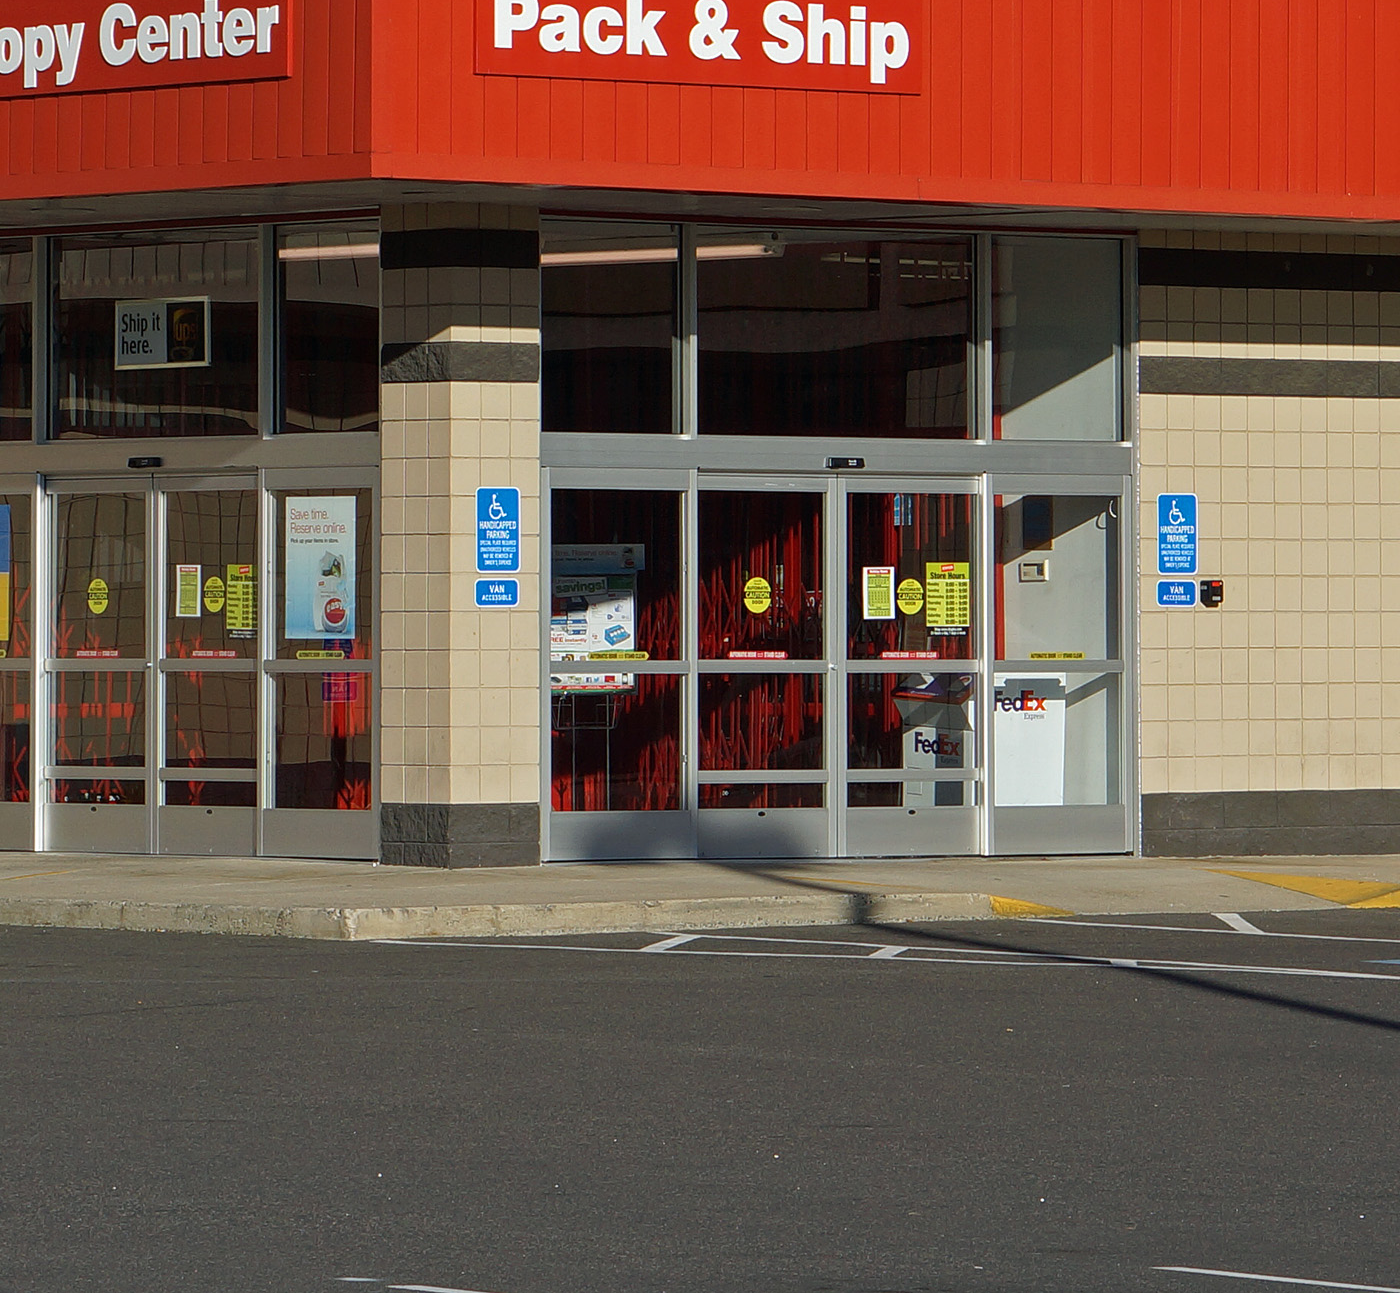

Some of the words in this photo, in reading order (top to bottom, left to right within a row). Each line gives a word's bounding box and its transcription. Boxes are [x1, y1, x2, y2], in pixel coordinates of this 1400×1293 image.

[762, 0, 910, 84] Ship
[121, 312, 148, 337] Ship
[152, 312, 161, 332] it
[121, 336, 153, 355] here.
[290, 508, 309, 520] Save
[311, 508, 329, 520] time.
[290, 522, 321, 534] Reserve
[323, 522, 347, 534] online.
[479, 521, 517, 530] HANDICAPPED
[1160, 526, 1194, 534] HANDICAPPED
[486, 530, 510, 539] PARKING
[489, 584, 505, 593] VAN
[1170, 586, 1184, 594] VAN
[994, 690, 1047, 711] FedEx
[915, 732, 960, 756] FedEx
